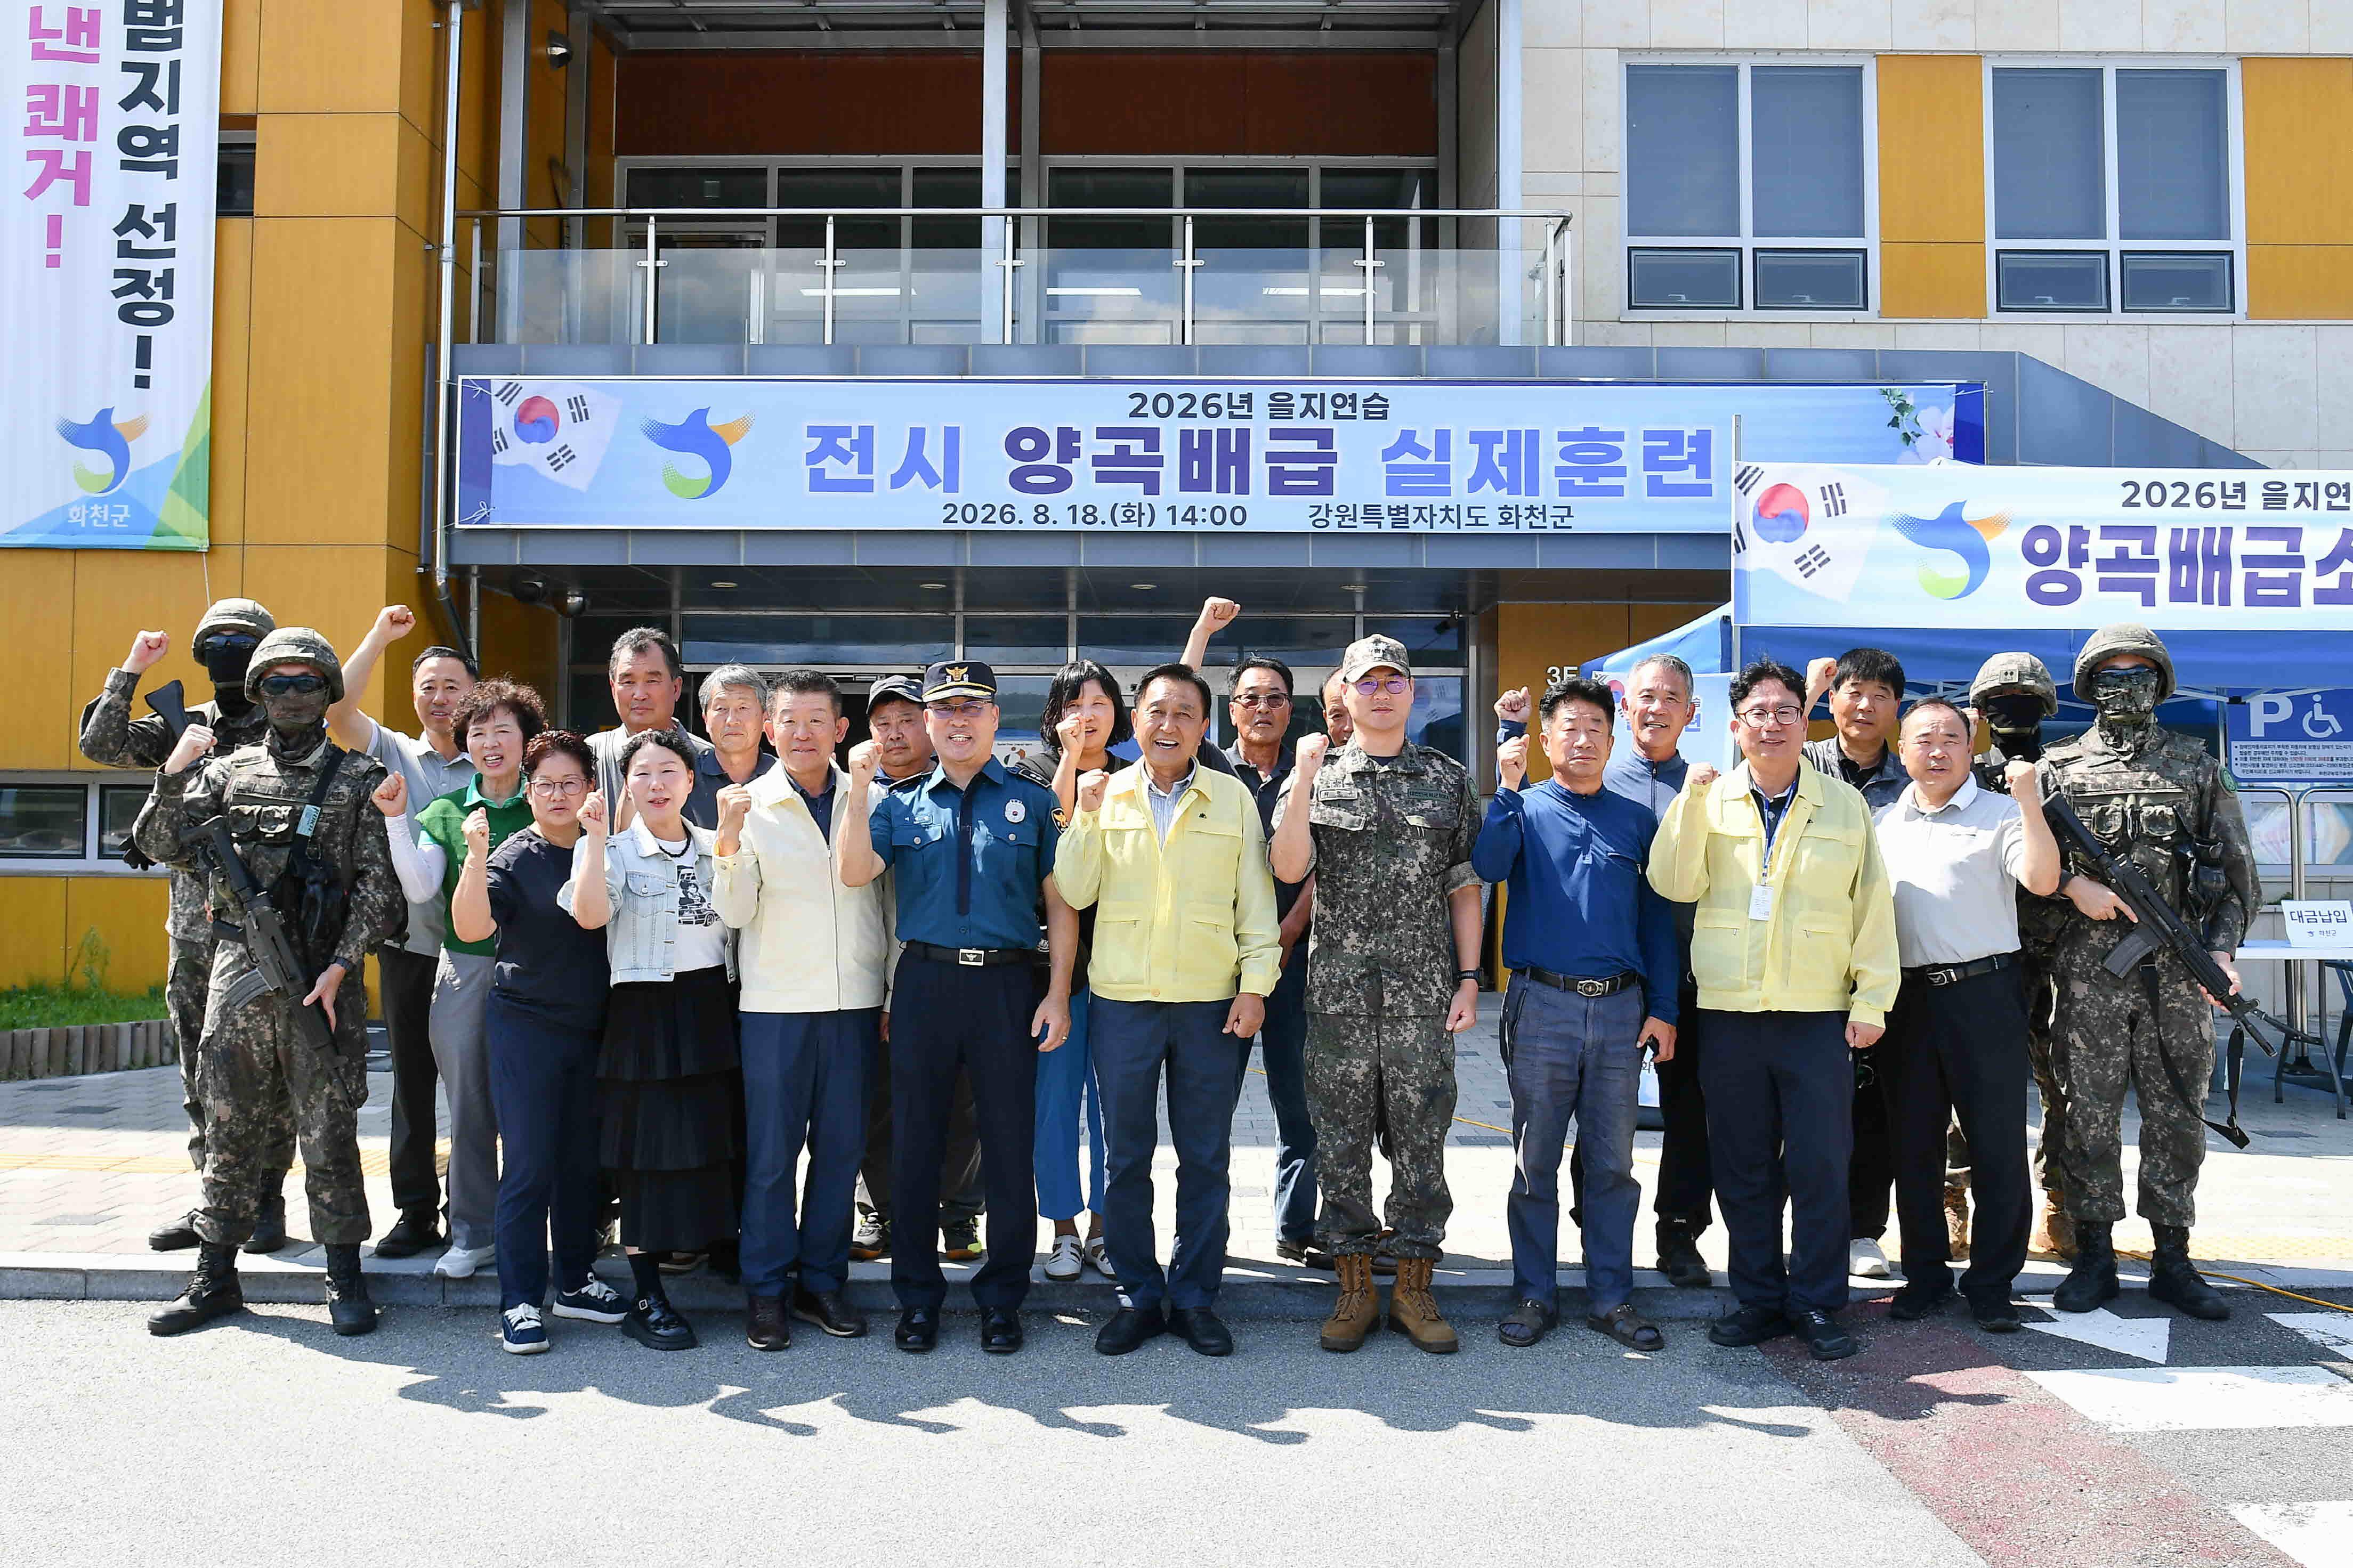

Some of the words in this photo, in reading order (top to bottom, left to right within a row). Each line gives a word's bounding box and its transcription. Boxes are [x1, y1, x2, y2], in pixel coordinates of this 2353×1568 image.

[25, 84, 99, 269] 쾌거!
[110, 202, 177, 389] 선정!
[1128, 392, 1254, 420] 2026년
[1267, 391, 1390, 421] 을지연습
[805, 425, 960, 494] 전시
[1004, 426, 1338, 497] 양곡배급
[1381, 426, 1713, 498] 실제훈련
[2121, 480, 2246, 510] 2026년
[68, 504, 131, 527] 화천군
[942, 502, 1024, 525] 2026.
[1032, 503, 1058, 525] 8.
[1067, 502, 1156, 528] 18.(화)
[1166, 505, 1247, 526] 14:00
[1308, 503, 1490, 530] 강원특별자치도
[1497, 503, 1575, 530] 화천군
[2250, 694, 2293, 737] P
[2289, 909, 2347, 923] 대금납입
